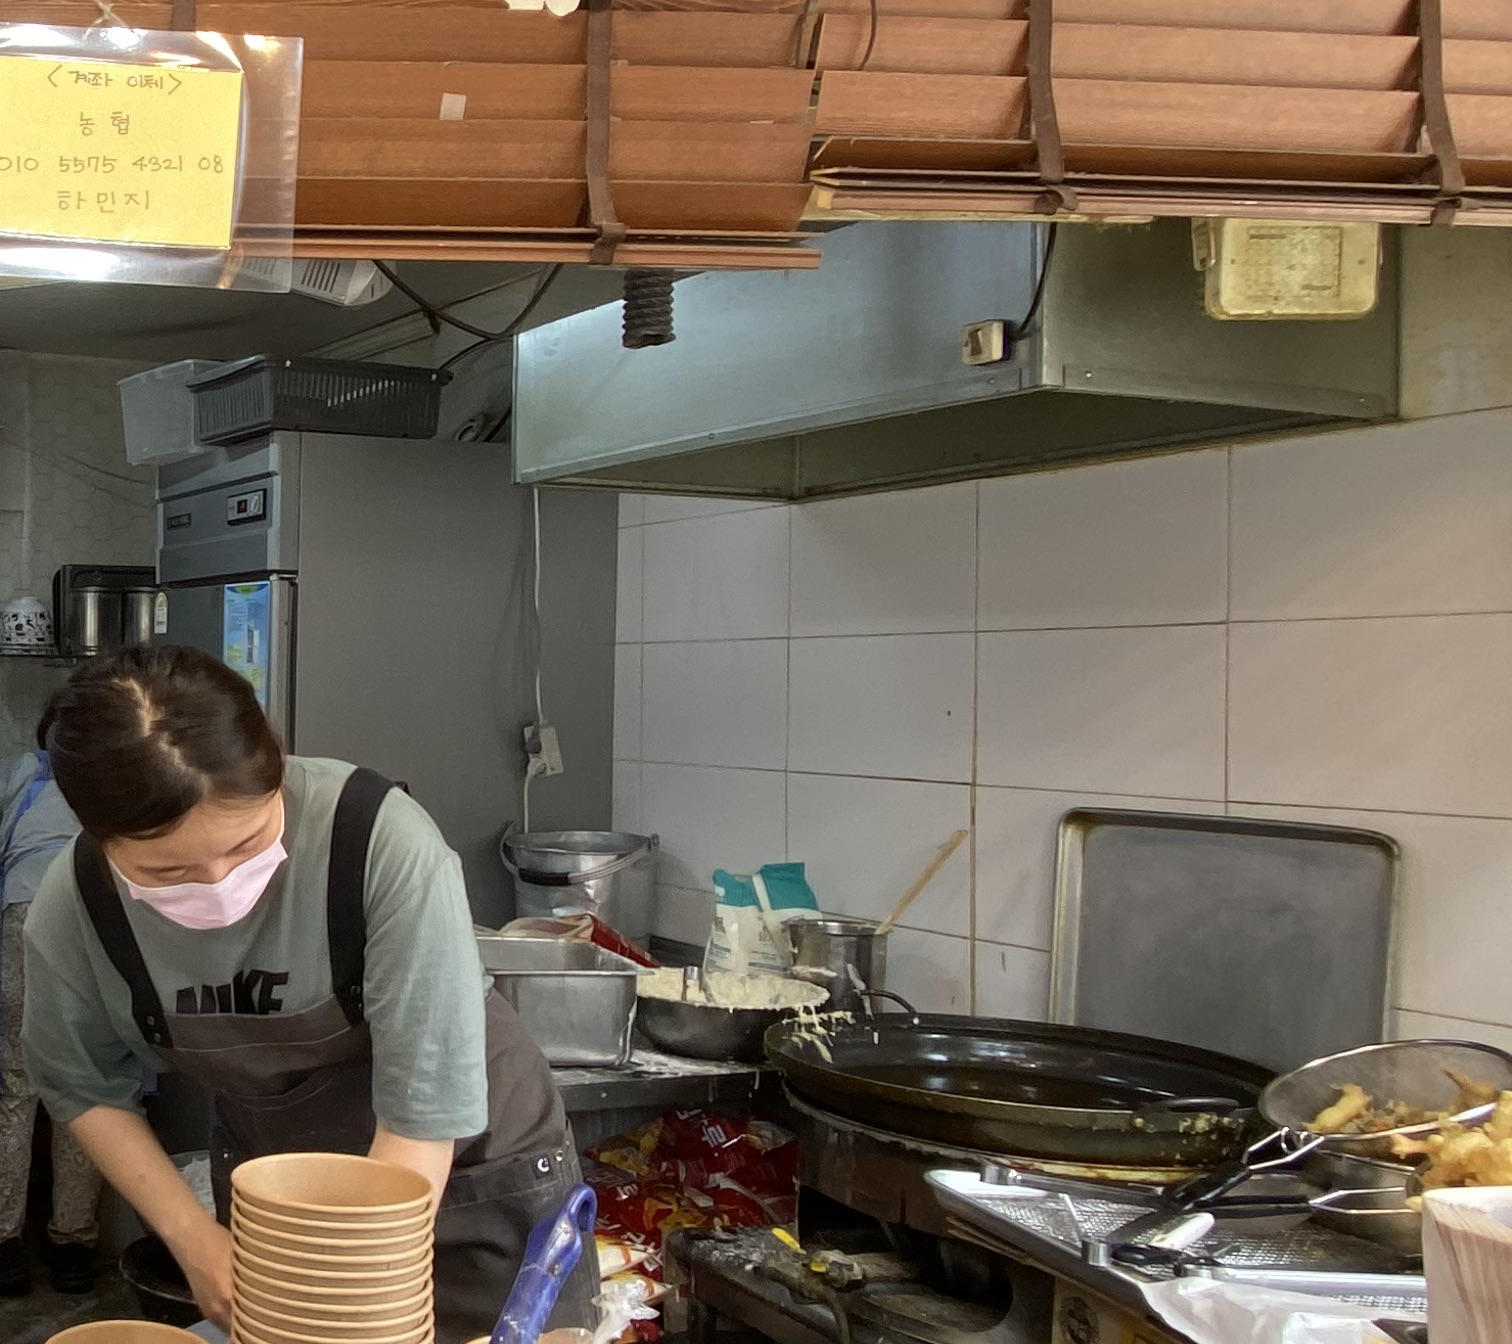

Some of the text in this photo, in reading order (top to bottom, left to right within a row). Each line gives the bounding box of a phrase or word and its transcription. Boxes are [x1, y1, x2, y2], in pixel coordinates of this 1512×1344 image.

[58, 155, 117, 173] 5575
[131, 155, 183, 171] 4321
[198, 155, 224, 172] 08
